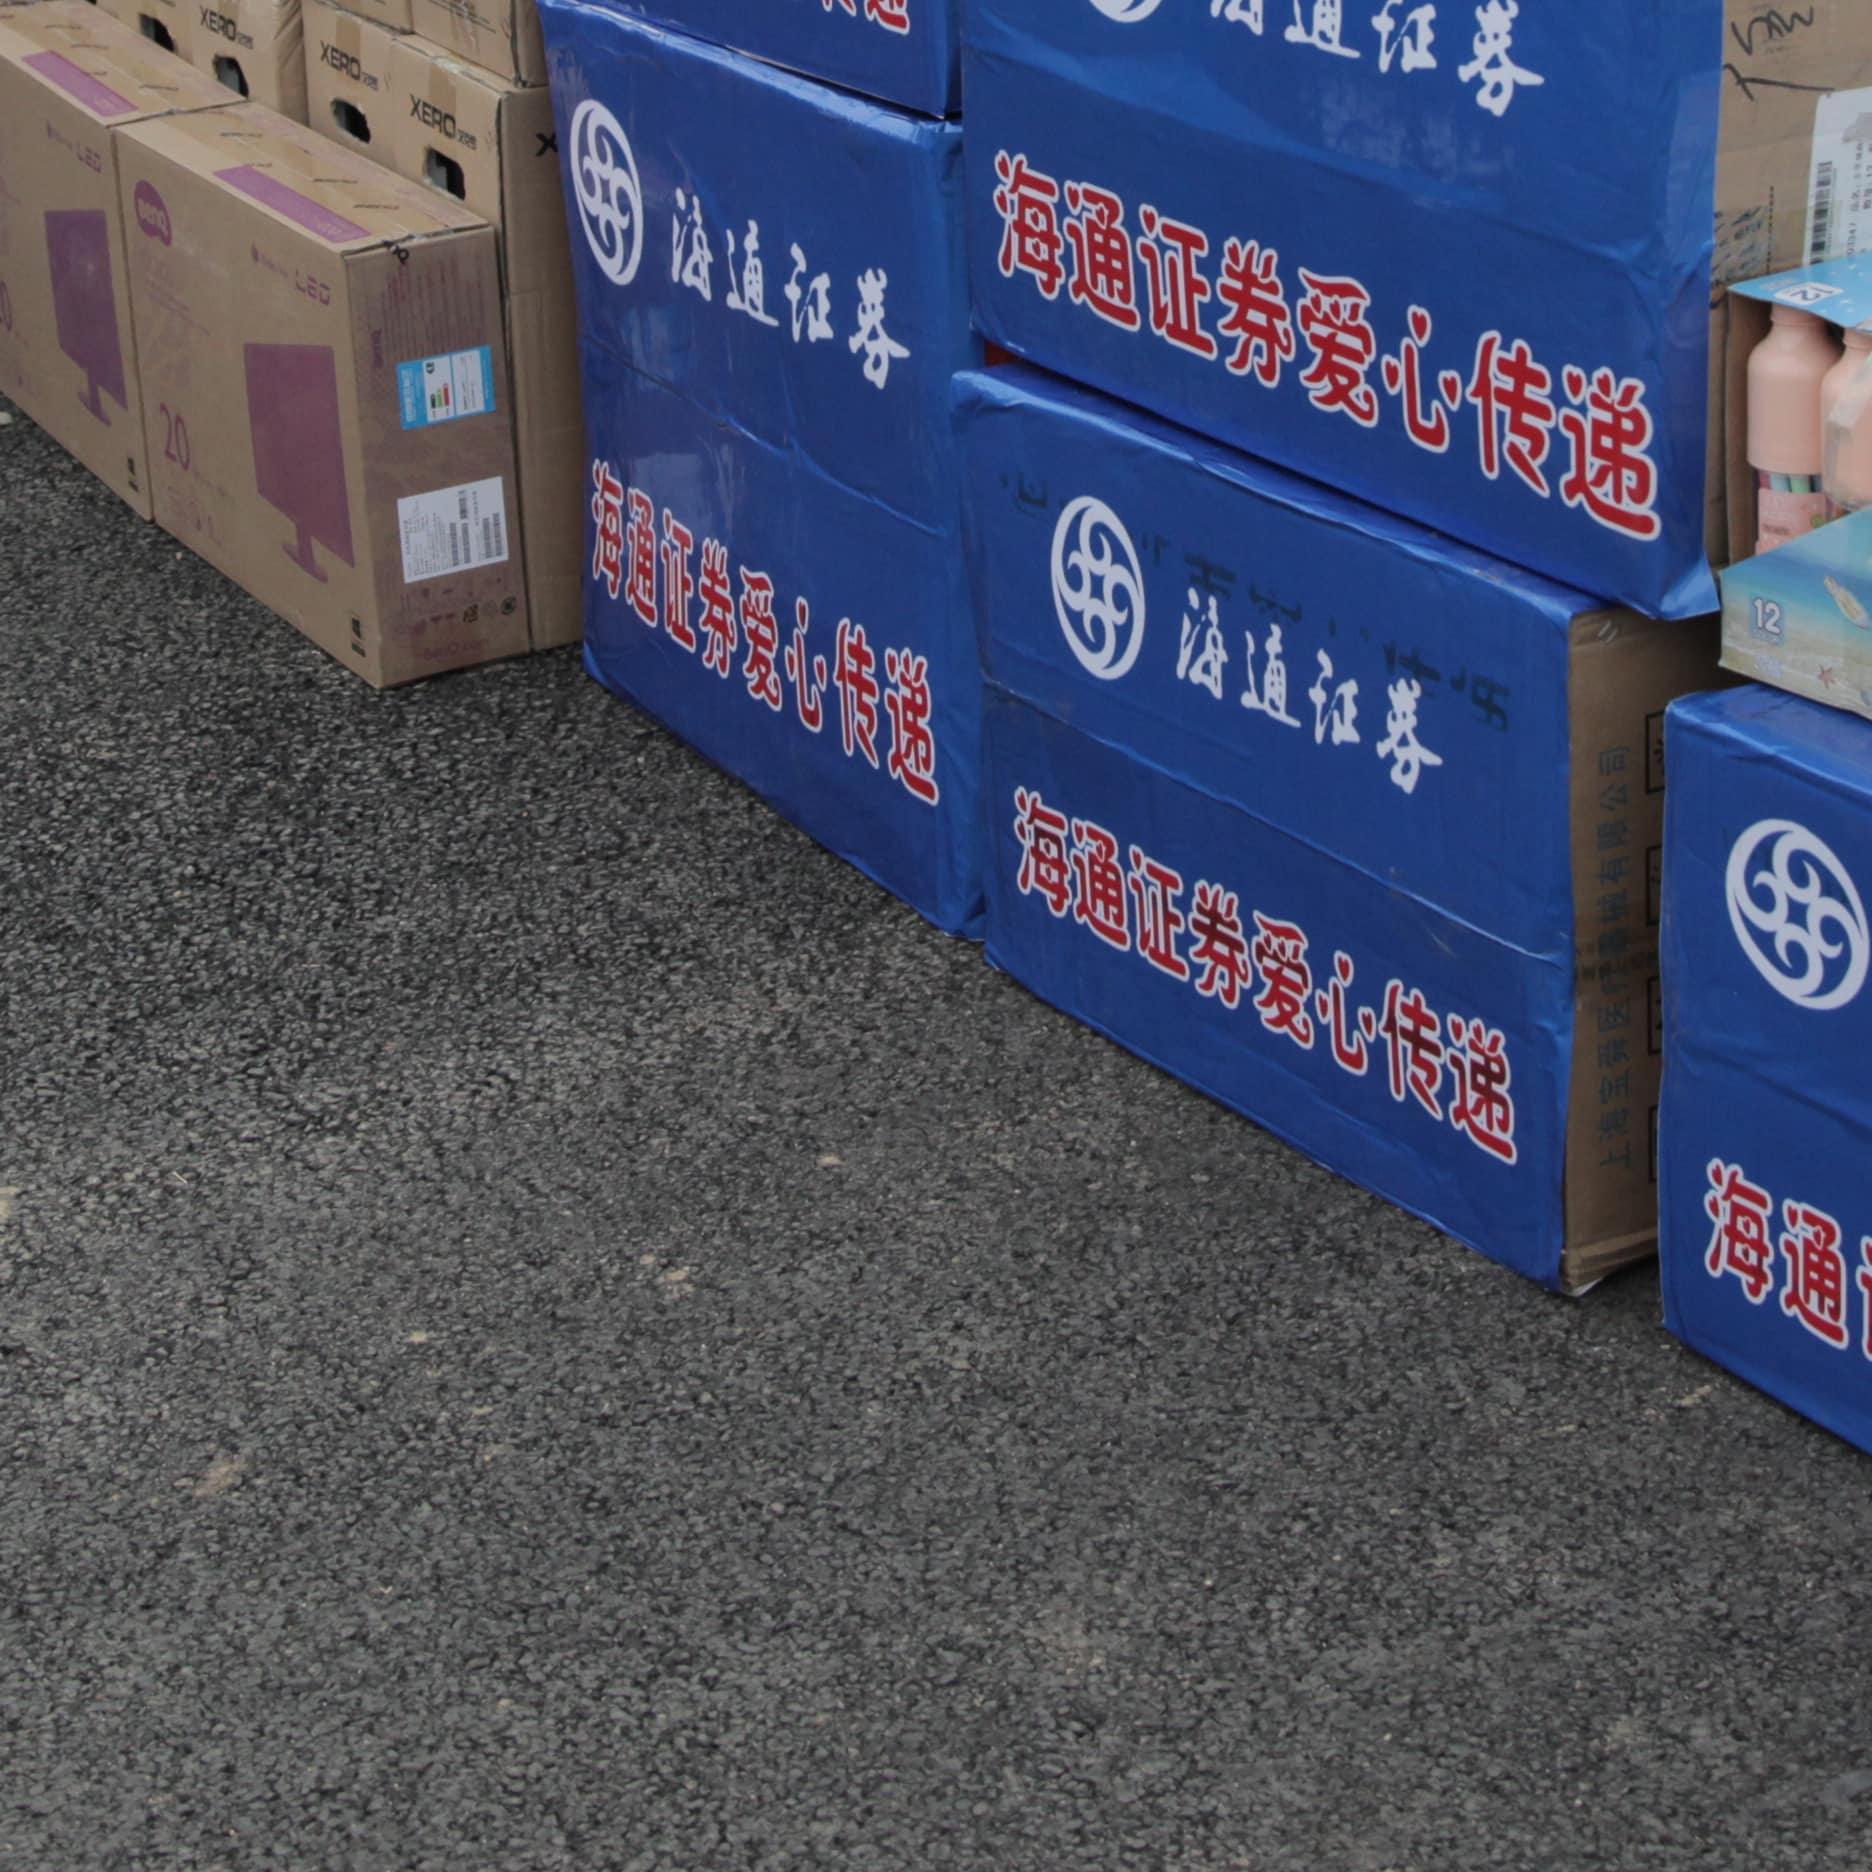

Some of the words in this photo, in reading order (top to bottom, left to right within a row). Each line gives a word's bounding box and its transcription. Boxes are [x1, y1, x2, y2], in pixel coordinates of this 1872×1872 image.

[199, 4, 236, 42] XERO
[319, 39, 362, 82] XERO
[409, 93, 457, 139] XERO
[296, 267, 331, 306] LED
[671, 184, 911, 391] 海通证券
[992, 146, 1664, 545] 海通证券爱心传递
[160, 402, 190, 472] 20
[590, 456, 940, 806] 海通证券爱心传递
[1752, 596, 1781, 635] 12
[1176, 586, 1444, 795] 海通证券
[1012, 784, 1519, 1167] 海通证券爱心传递
